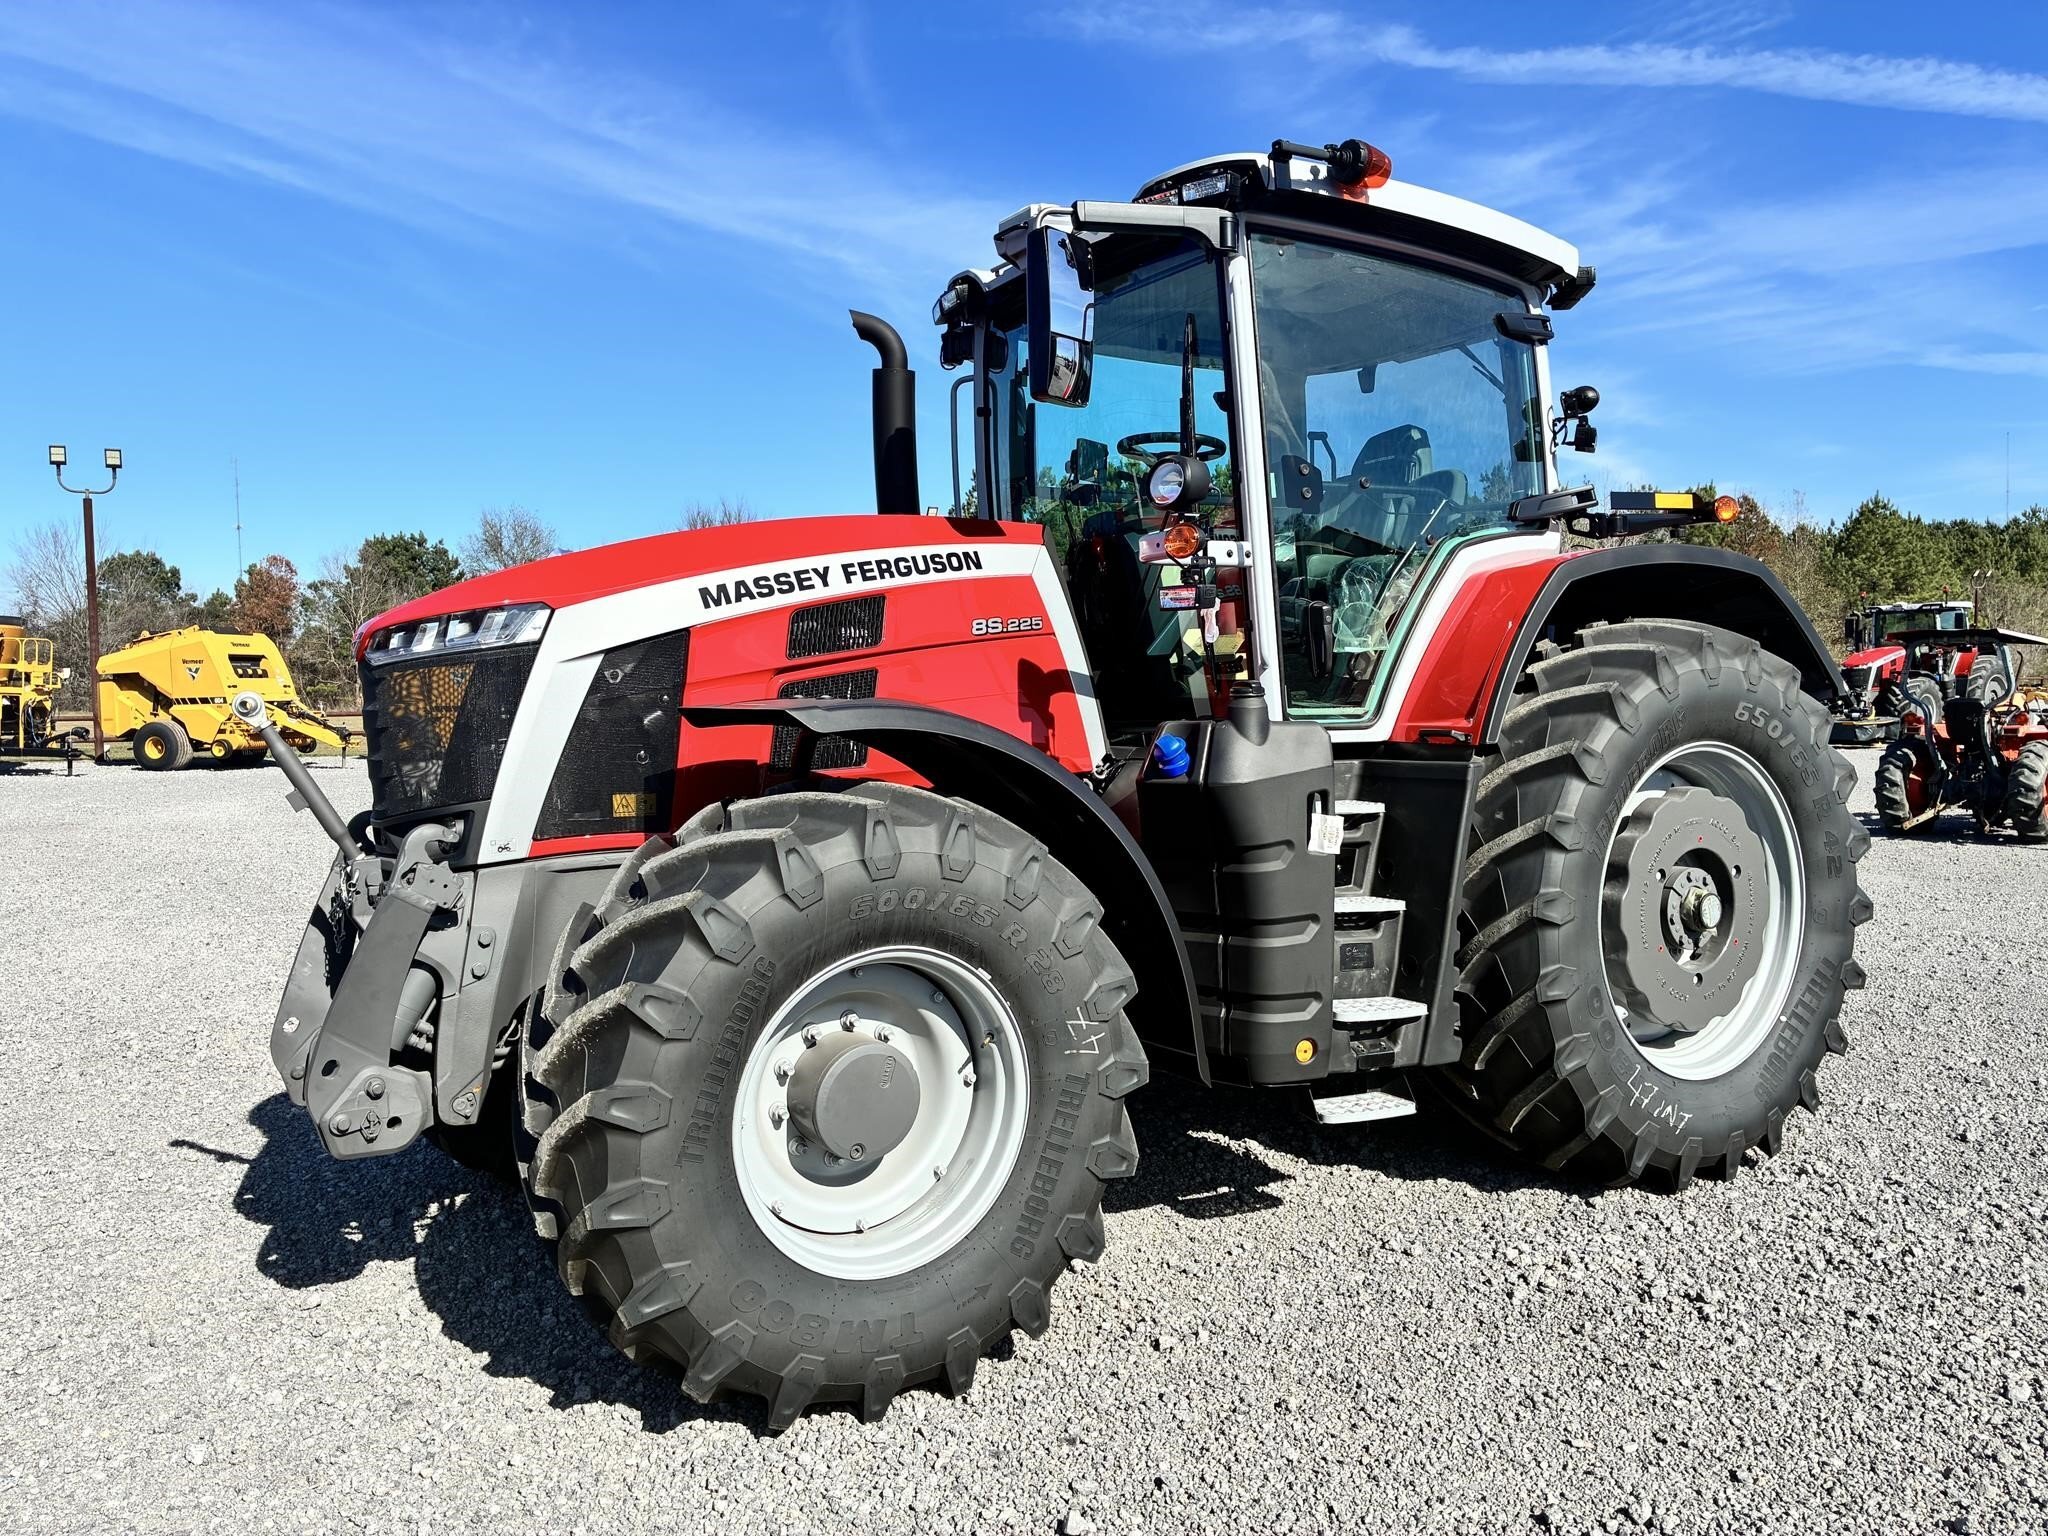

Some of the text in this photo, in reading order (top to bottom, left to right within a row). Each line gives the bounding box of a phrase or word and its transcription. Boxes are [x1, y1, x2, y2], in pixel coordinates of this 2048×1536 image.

[698, 550, 983, 609] MASSEY FERGUSON
[971, 616, 1043, 636] 8S.225
[1734, 701, 1843, 879] 650/65 R 42
[849, 887, 1000, 928] 600/65
[1000, 921, 1029, 950] R
[1024, 948, 1066, 995] 28
[674, 954, 777, 1168] TRELLEBORG
[1753, 956, 1837, 1104] TRELLEBORG
[1009, 1071, 1092, 1261] TRELLEBORG
[728, 1278, 925, 1354] TM800
